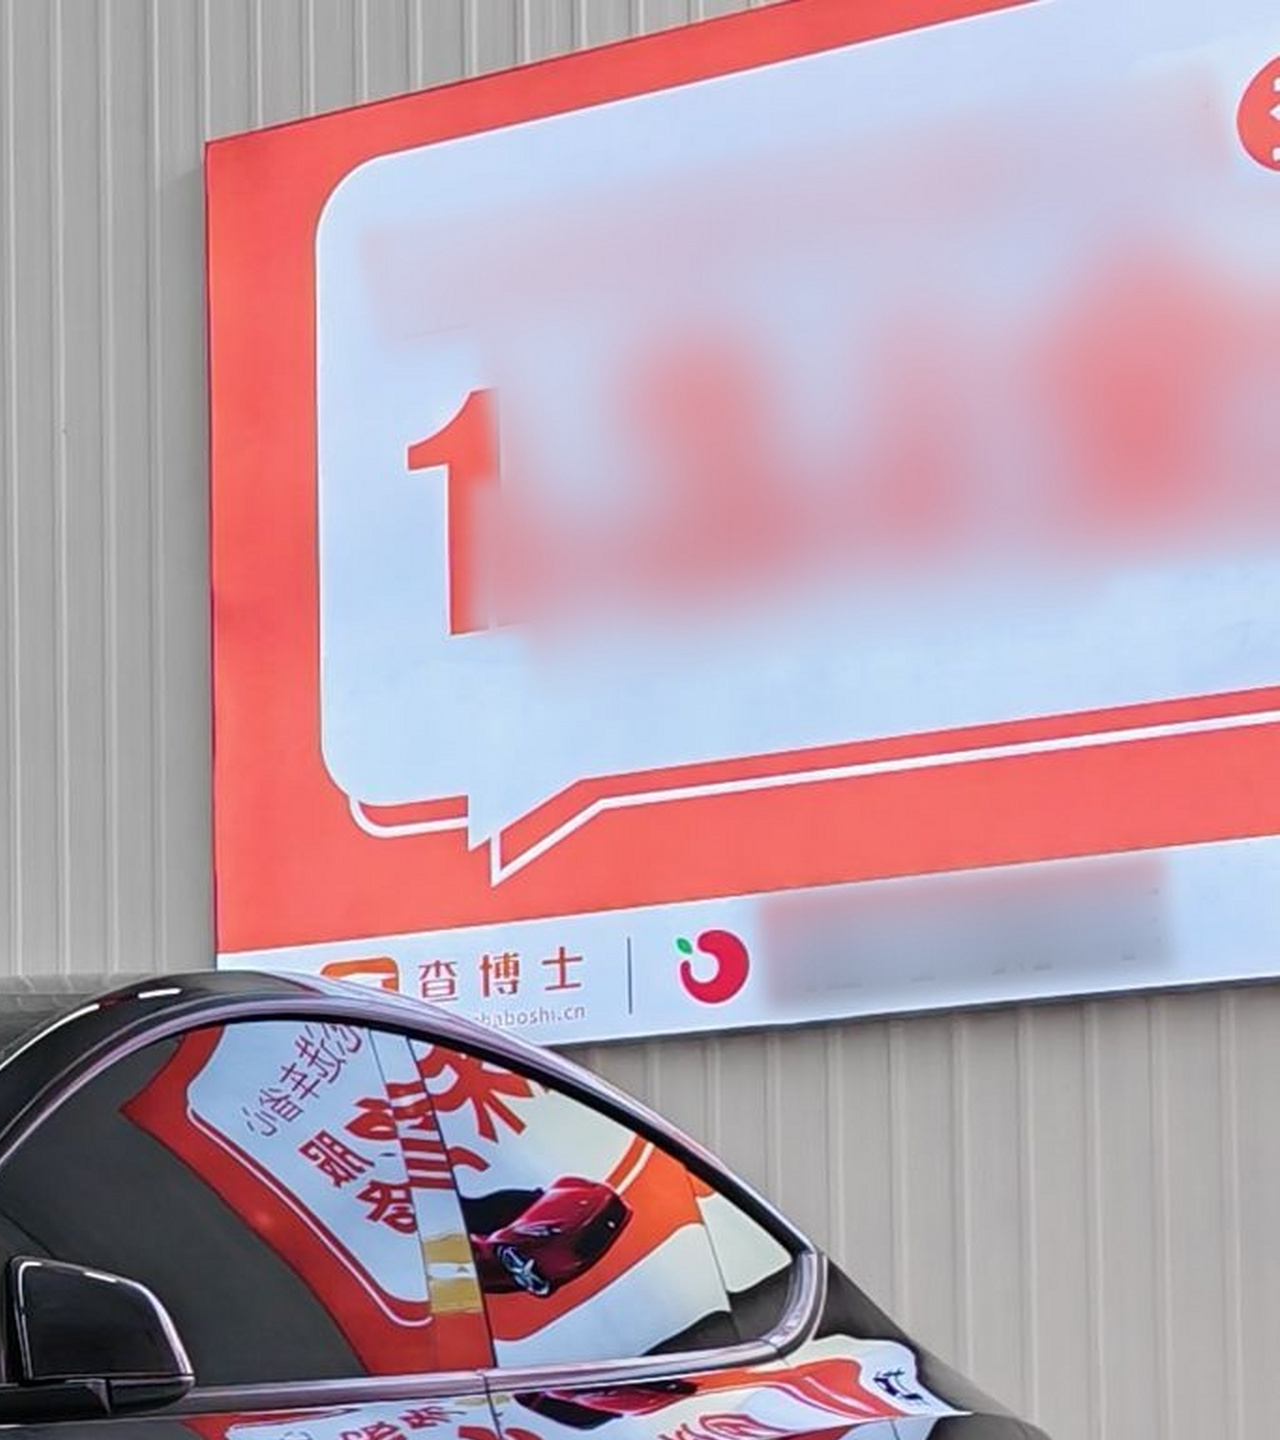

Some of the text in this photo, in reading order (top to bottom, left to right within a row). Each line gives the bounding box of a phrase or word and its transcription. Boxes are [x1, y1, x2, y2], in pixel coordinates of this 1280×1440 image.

[417, 945, 583, 1002] 查博士
[474, 1006, 585, 1026] haboshi.cn
